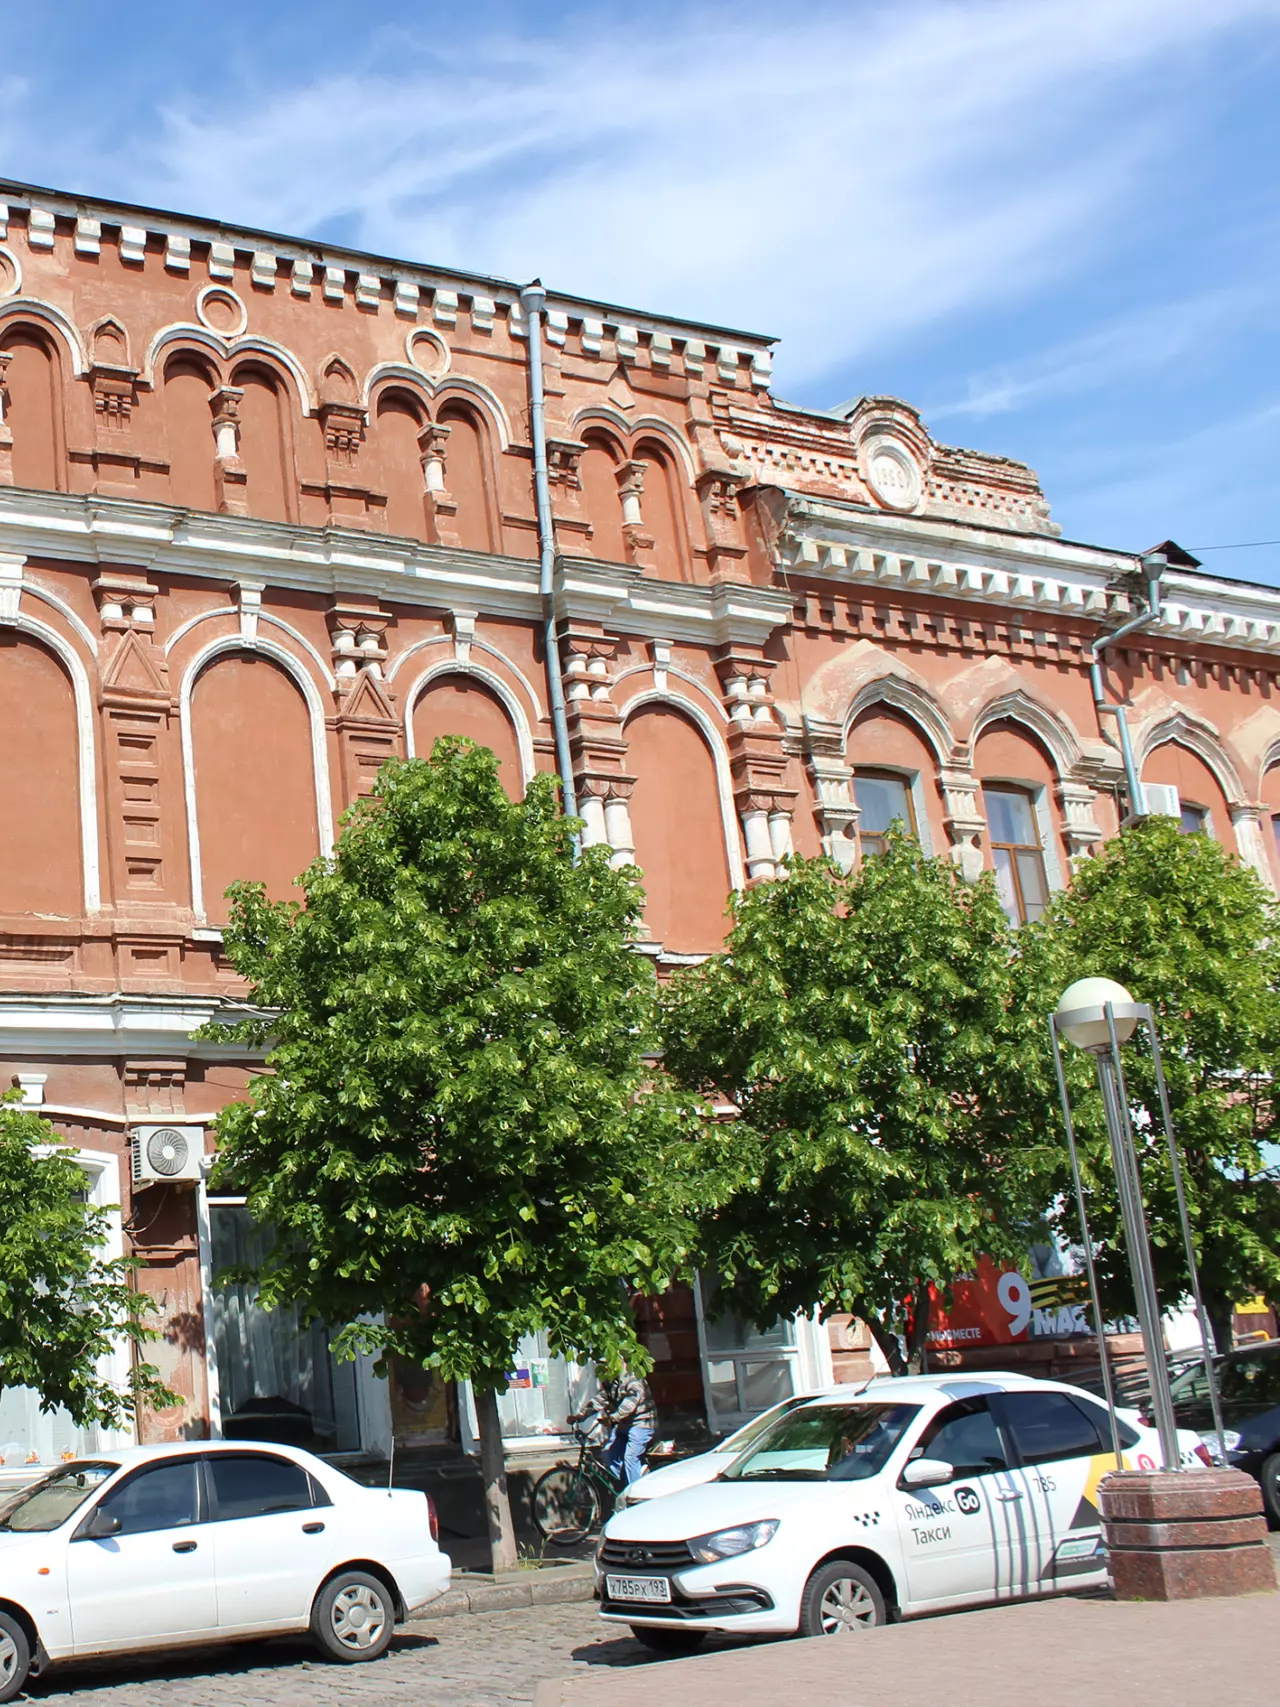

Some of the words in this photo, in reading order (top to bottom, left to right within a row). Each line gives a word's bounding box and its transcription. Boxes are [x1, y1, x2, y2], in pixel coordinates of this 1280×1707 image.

[997, 1272, 1032, 1336] 9
[1032, 1476, 1057, 1493] 785
[905, 1499, 957, 1521] Яндекс
[957, 1491, 979, 1511] Go
[912, 1526, 952, 1545] Такси
